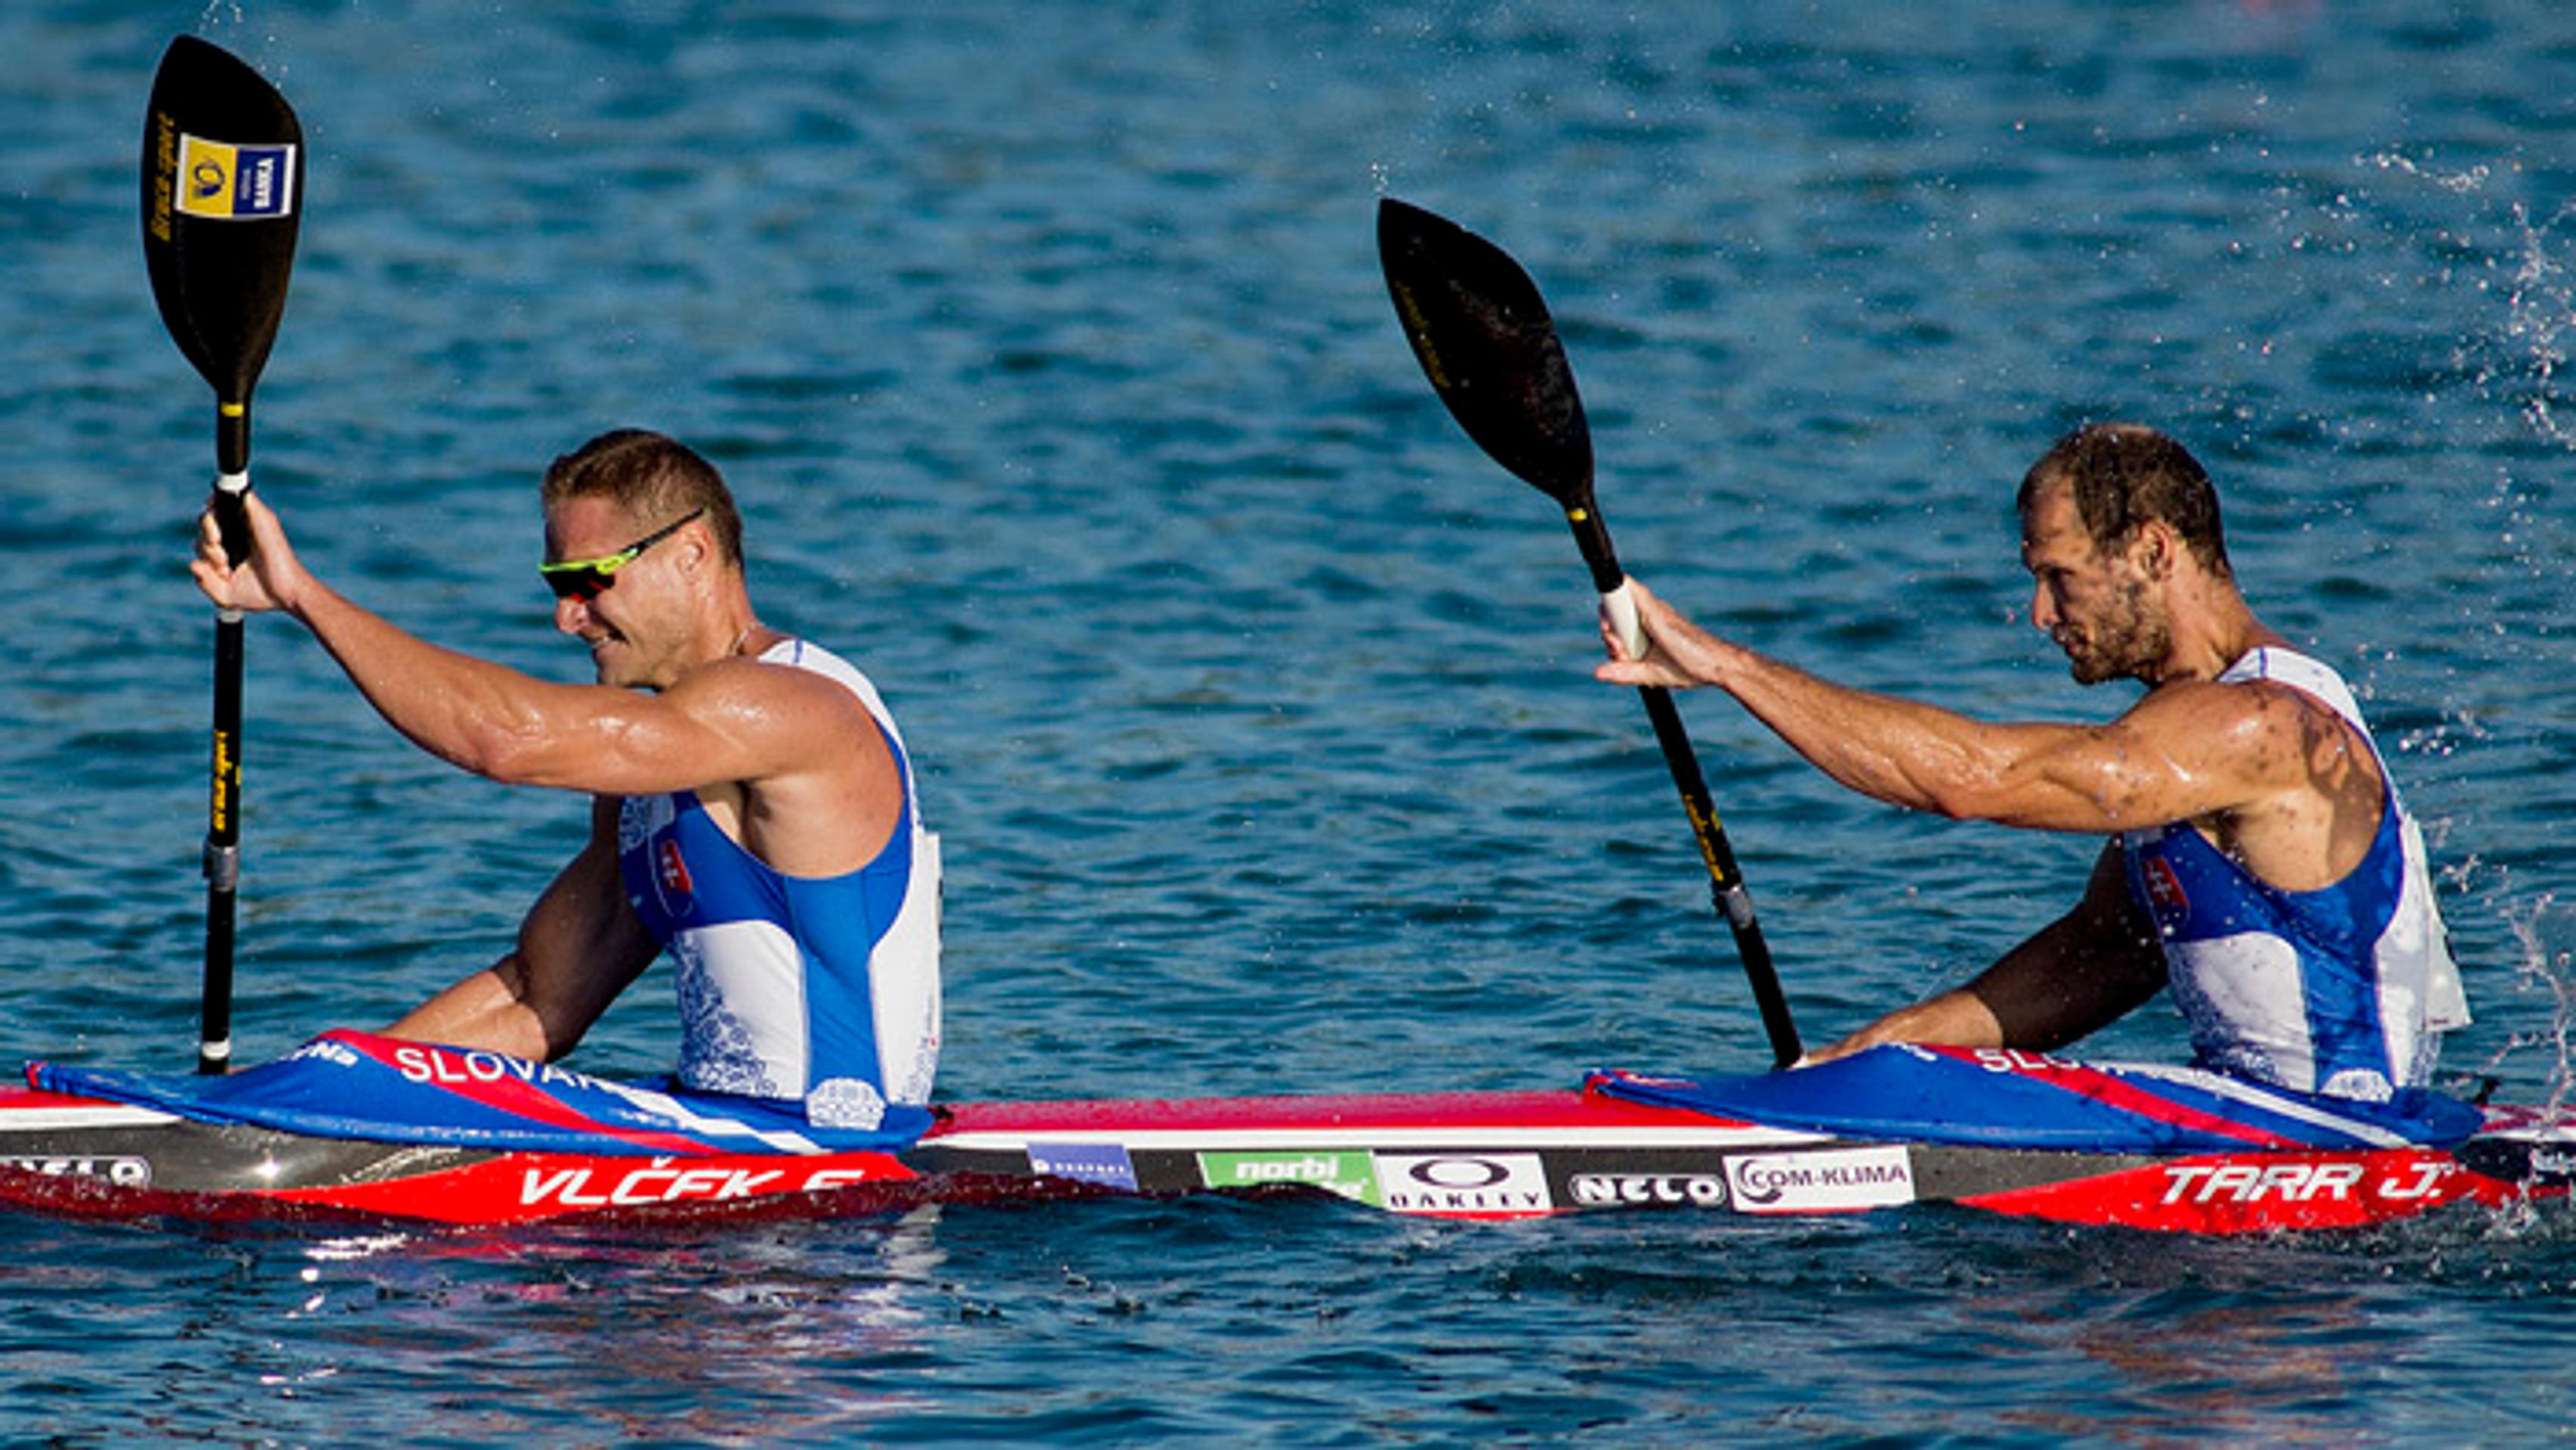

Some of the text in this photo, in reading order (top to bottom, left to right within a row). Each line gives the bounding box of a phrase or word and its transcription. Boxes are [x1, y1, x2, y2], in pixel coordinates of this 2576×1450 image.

[2161, 1163, 2442, 1204] TARR J.
[1391, 1192, 1538, 1208] OAKLEY
